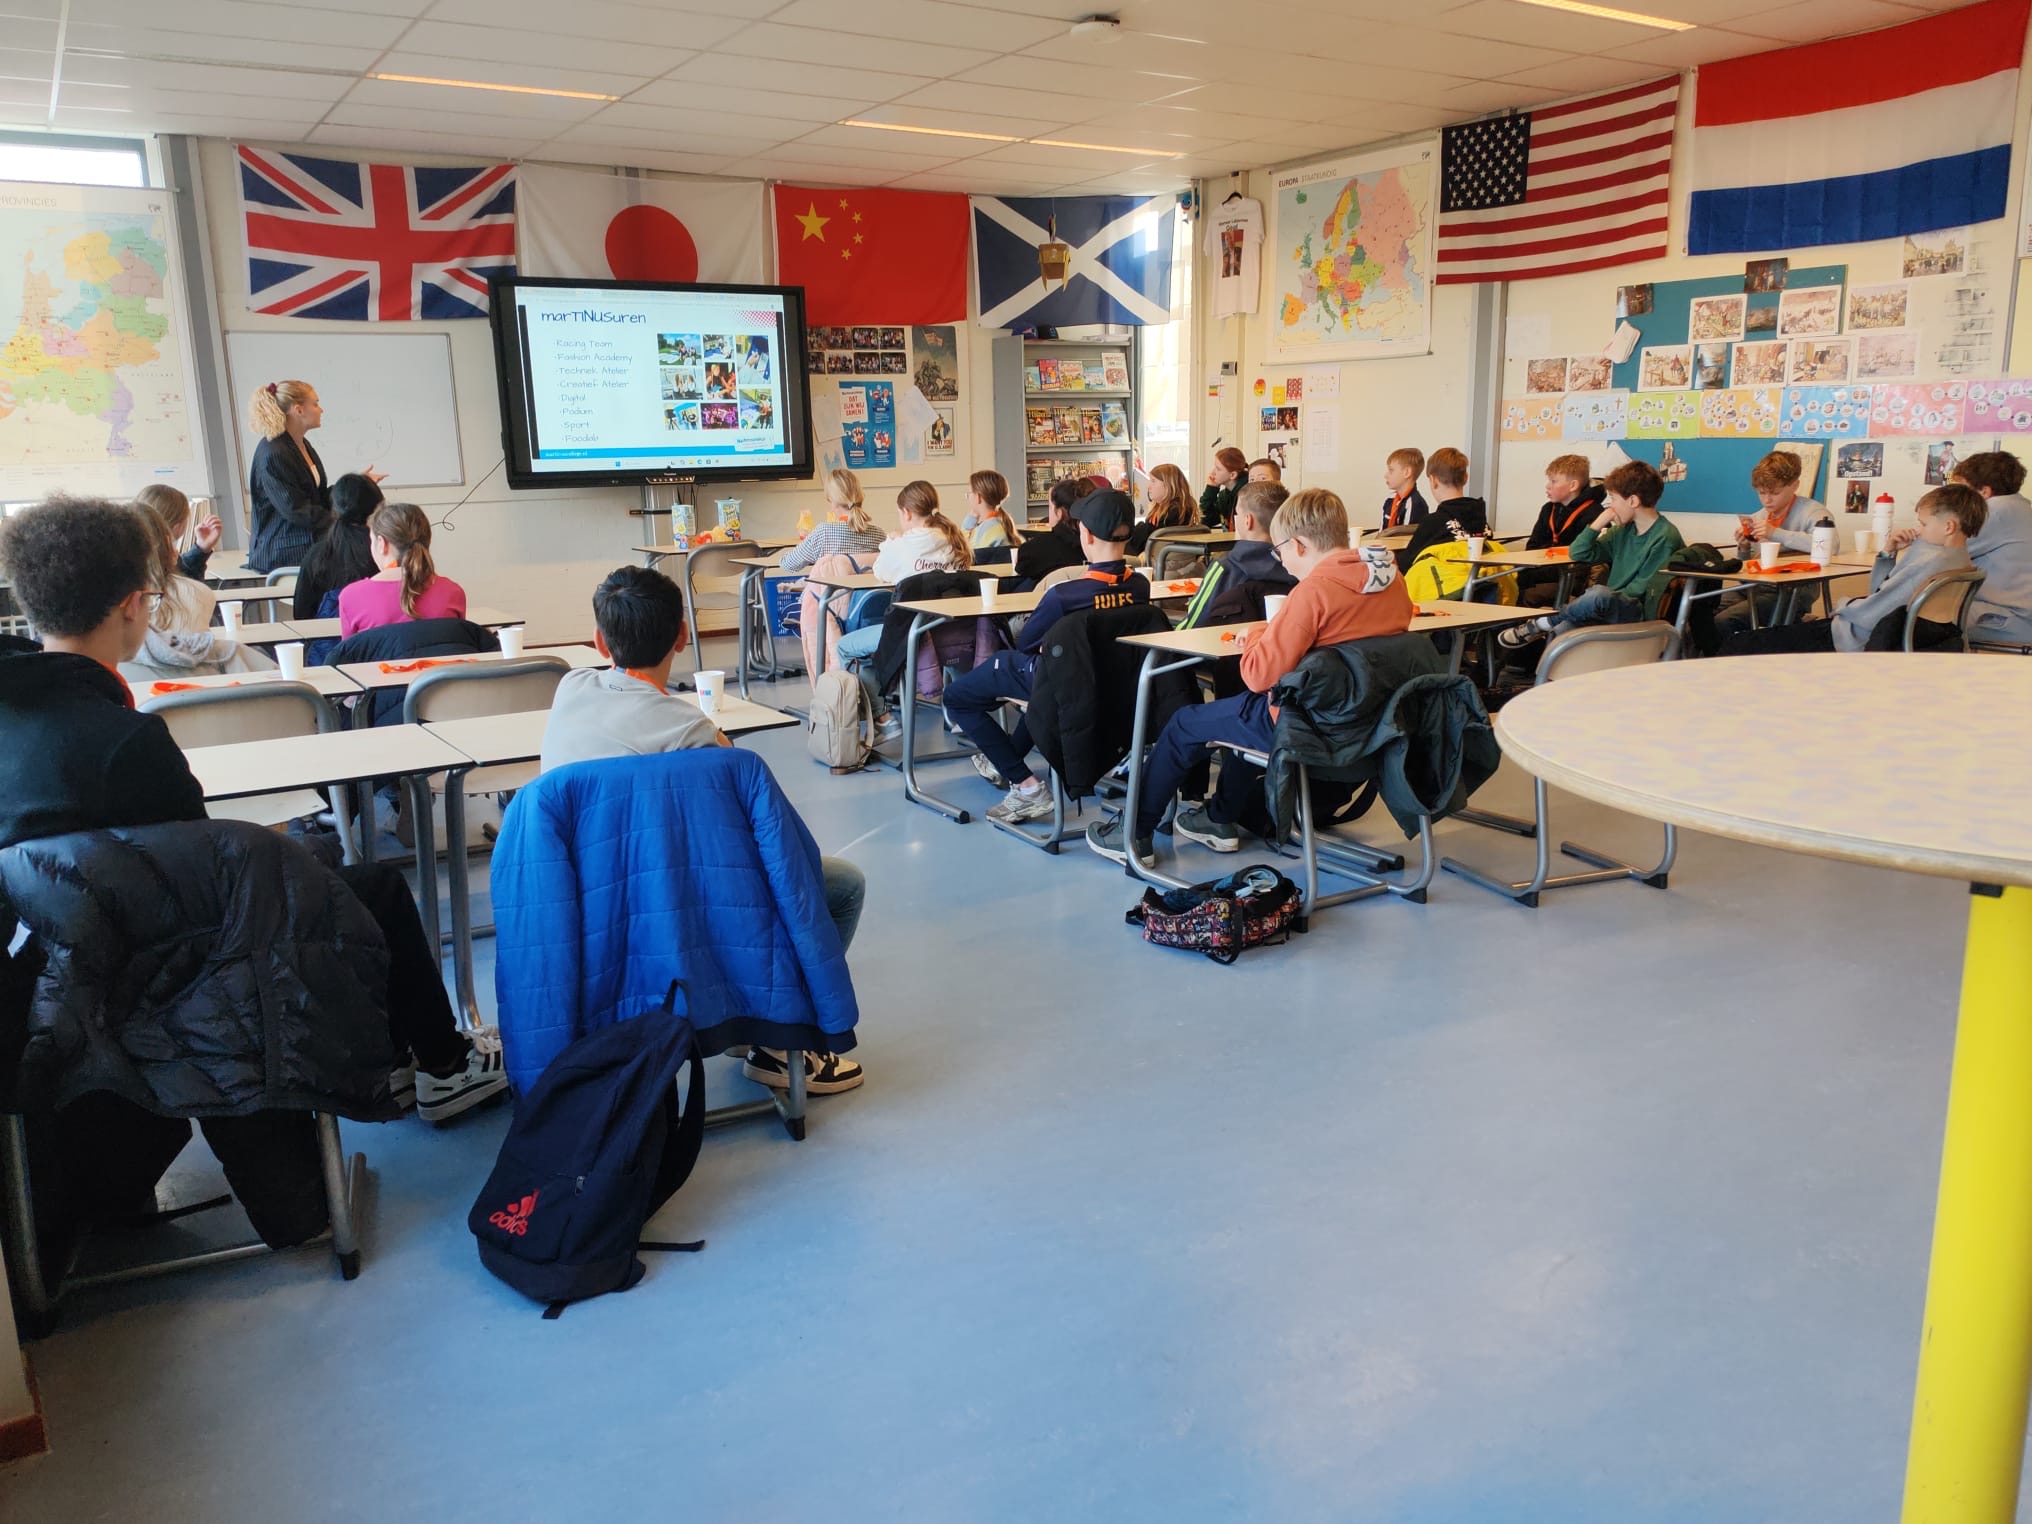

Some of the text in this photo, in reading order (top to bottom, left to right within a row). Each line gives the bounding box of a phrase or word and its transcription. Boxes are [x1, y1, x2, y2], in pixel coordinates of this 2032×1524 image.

[1279, 176, 1298, 188] EUROPA
[541, 309, 646, 323] marTINUSuren
[556, 339, 613, 351] Racing Team
[557, 353, 633, 364] Fashion Academy
[602, 380, 629, 388] Atelier
[561, 394, 586, 405] Digital
[562, 407, 593, 416] Podium
[564, 421, 590, 432] Sport
